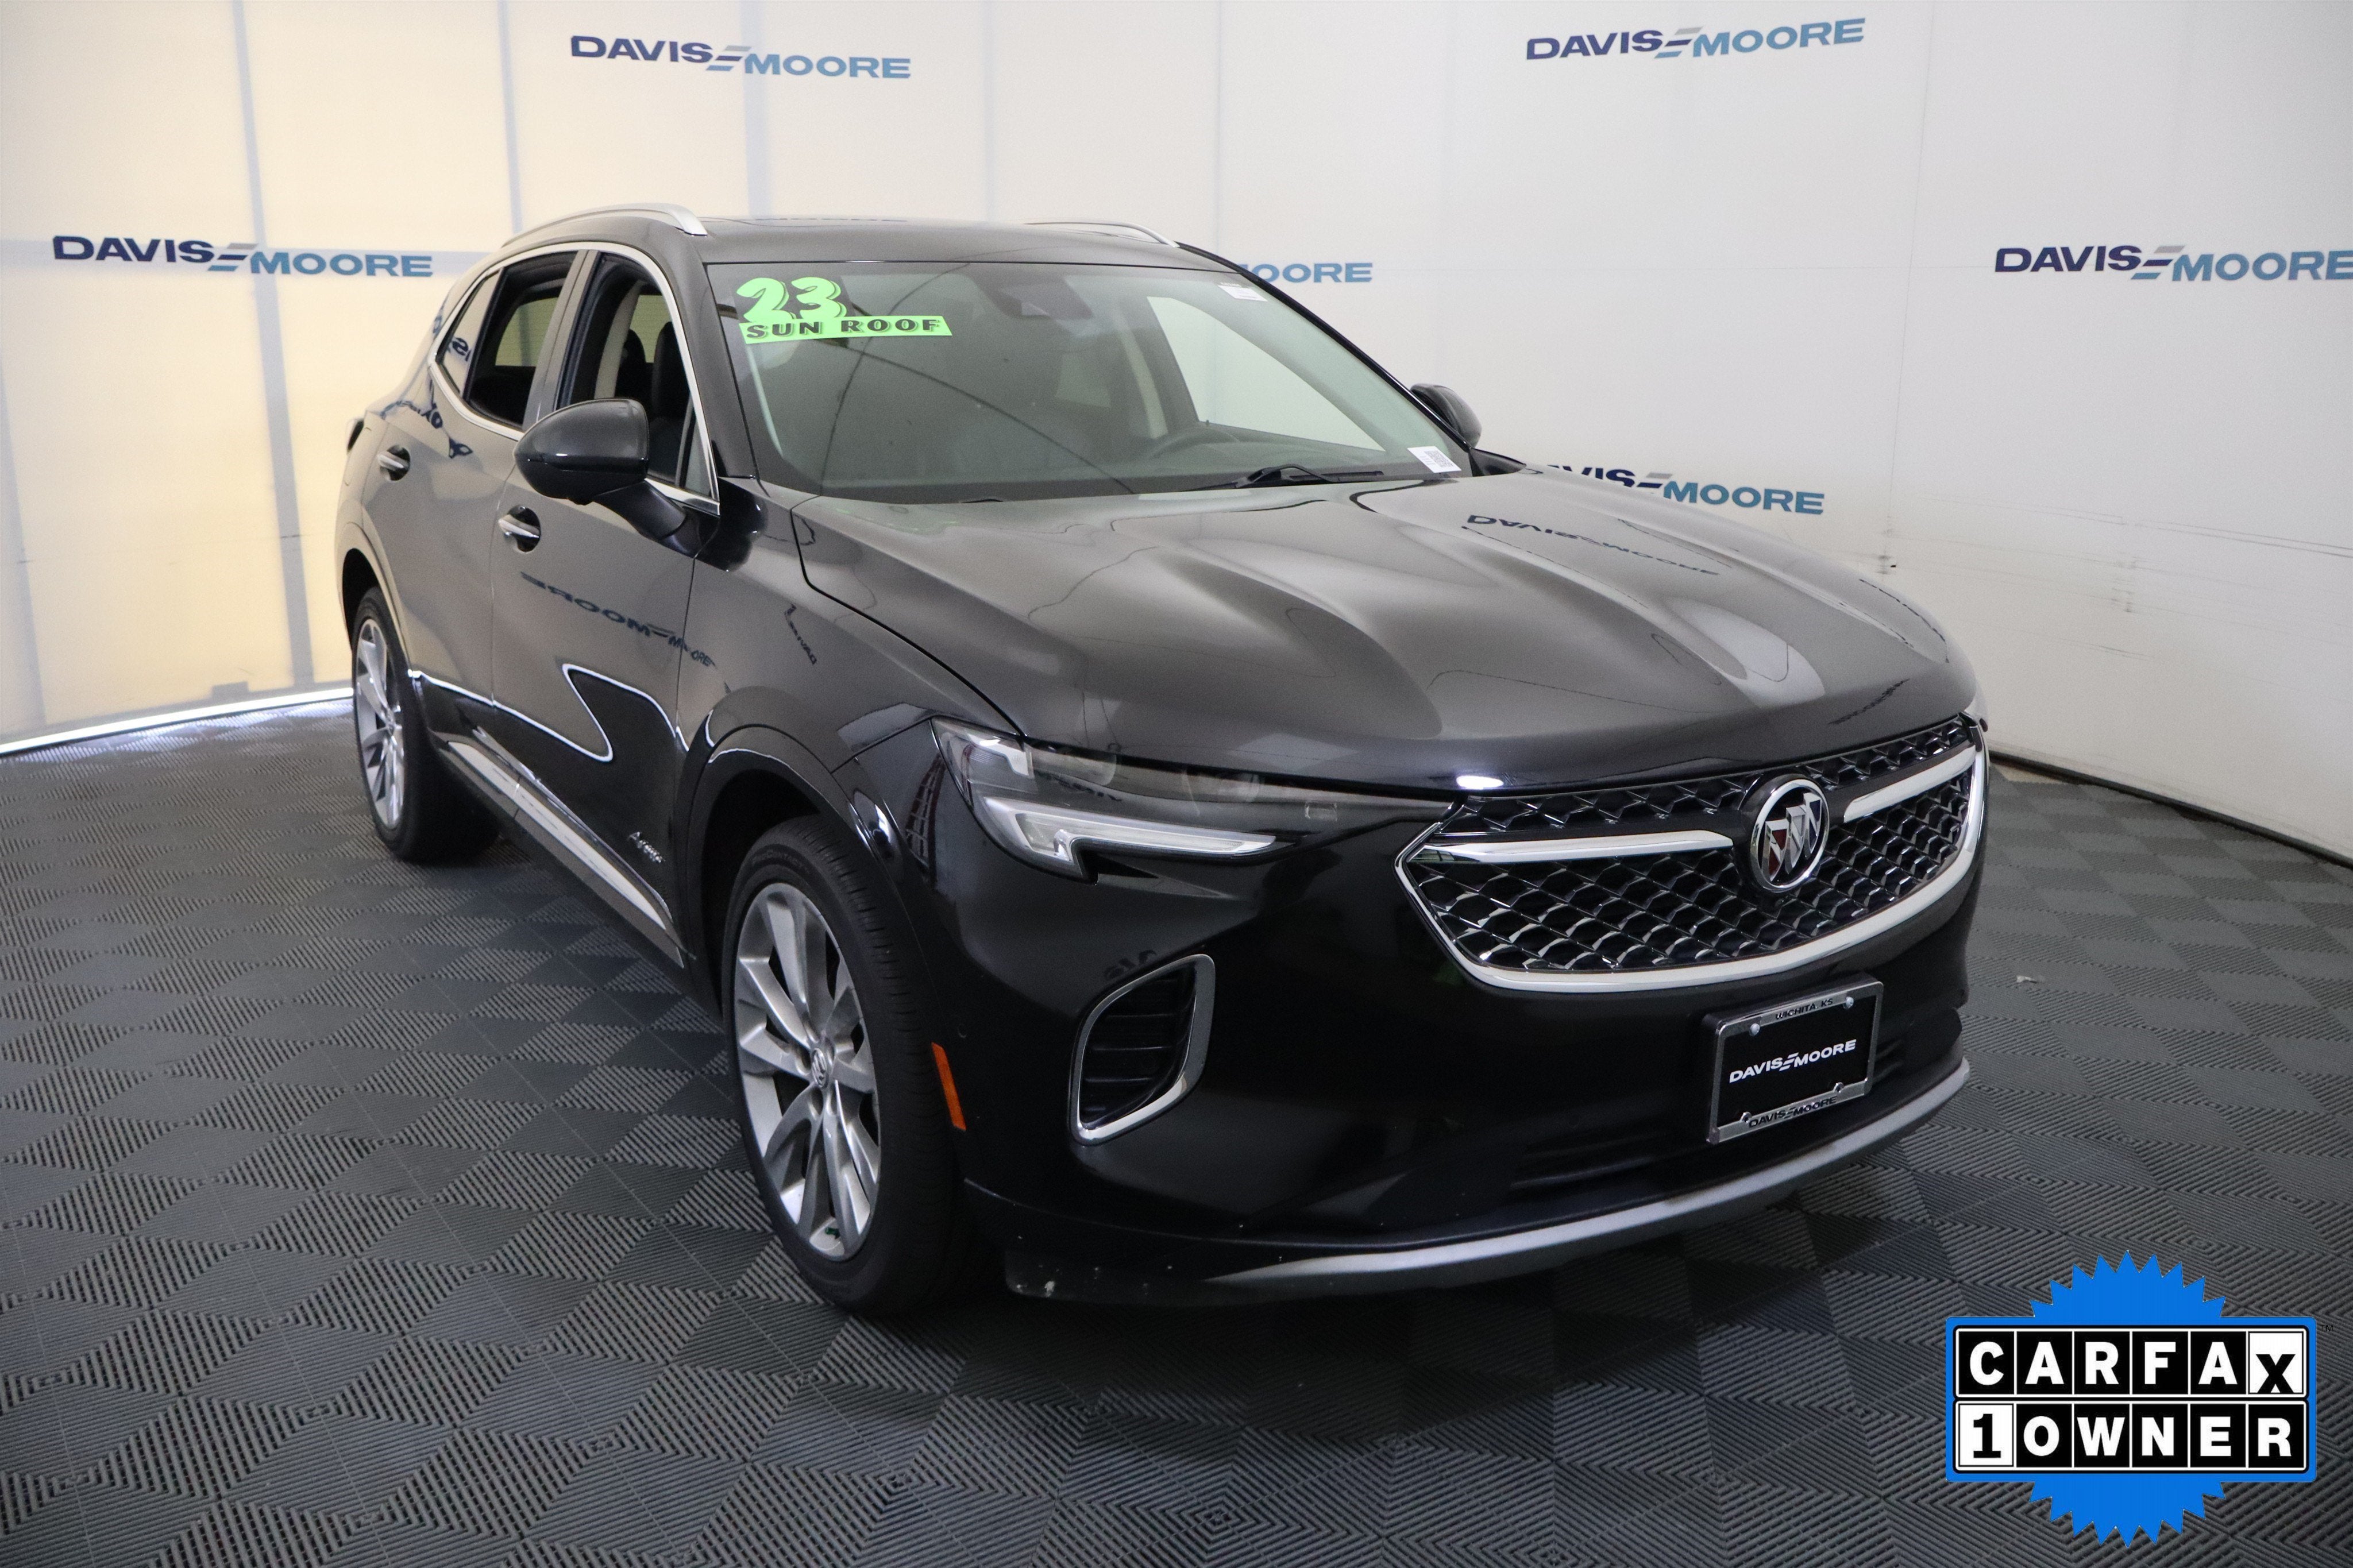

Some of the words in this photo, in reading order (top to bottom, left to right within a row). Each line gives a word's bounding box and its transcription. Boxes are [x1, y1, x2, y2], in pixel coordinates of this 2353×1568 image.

[1526, 30, 1664, 60] DAVIS
[1692, 17, 1866, 58] MOORE
[570, 35, 713, 63] DAVIS
[744, 53, 912, 79] MOORE
[52, 235, 215, 264] DAVIS
[250, 251, 433, 277] MOORE
[1239, 262, 1373, 283] OORE
[1995, 245, 2142, 272] DAVIS
[736, 276, 847, 322] 23
[746, 321, 821, 339] SUN
[840, 318, 940, 333] ROOF
[1663, 480, 1825, 515] MOORE
[1820, 998, 1834, 1007] KS
[1729, 1056, 1784, 1084] DAVIS
[1793, 1038, 1857, 1068] MOORE
[1748, 1110, 1785, 1128] DAVIS
[1792, 1095, 1838, 1117] MOORE
